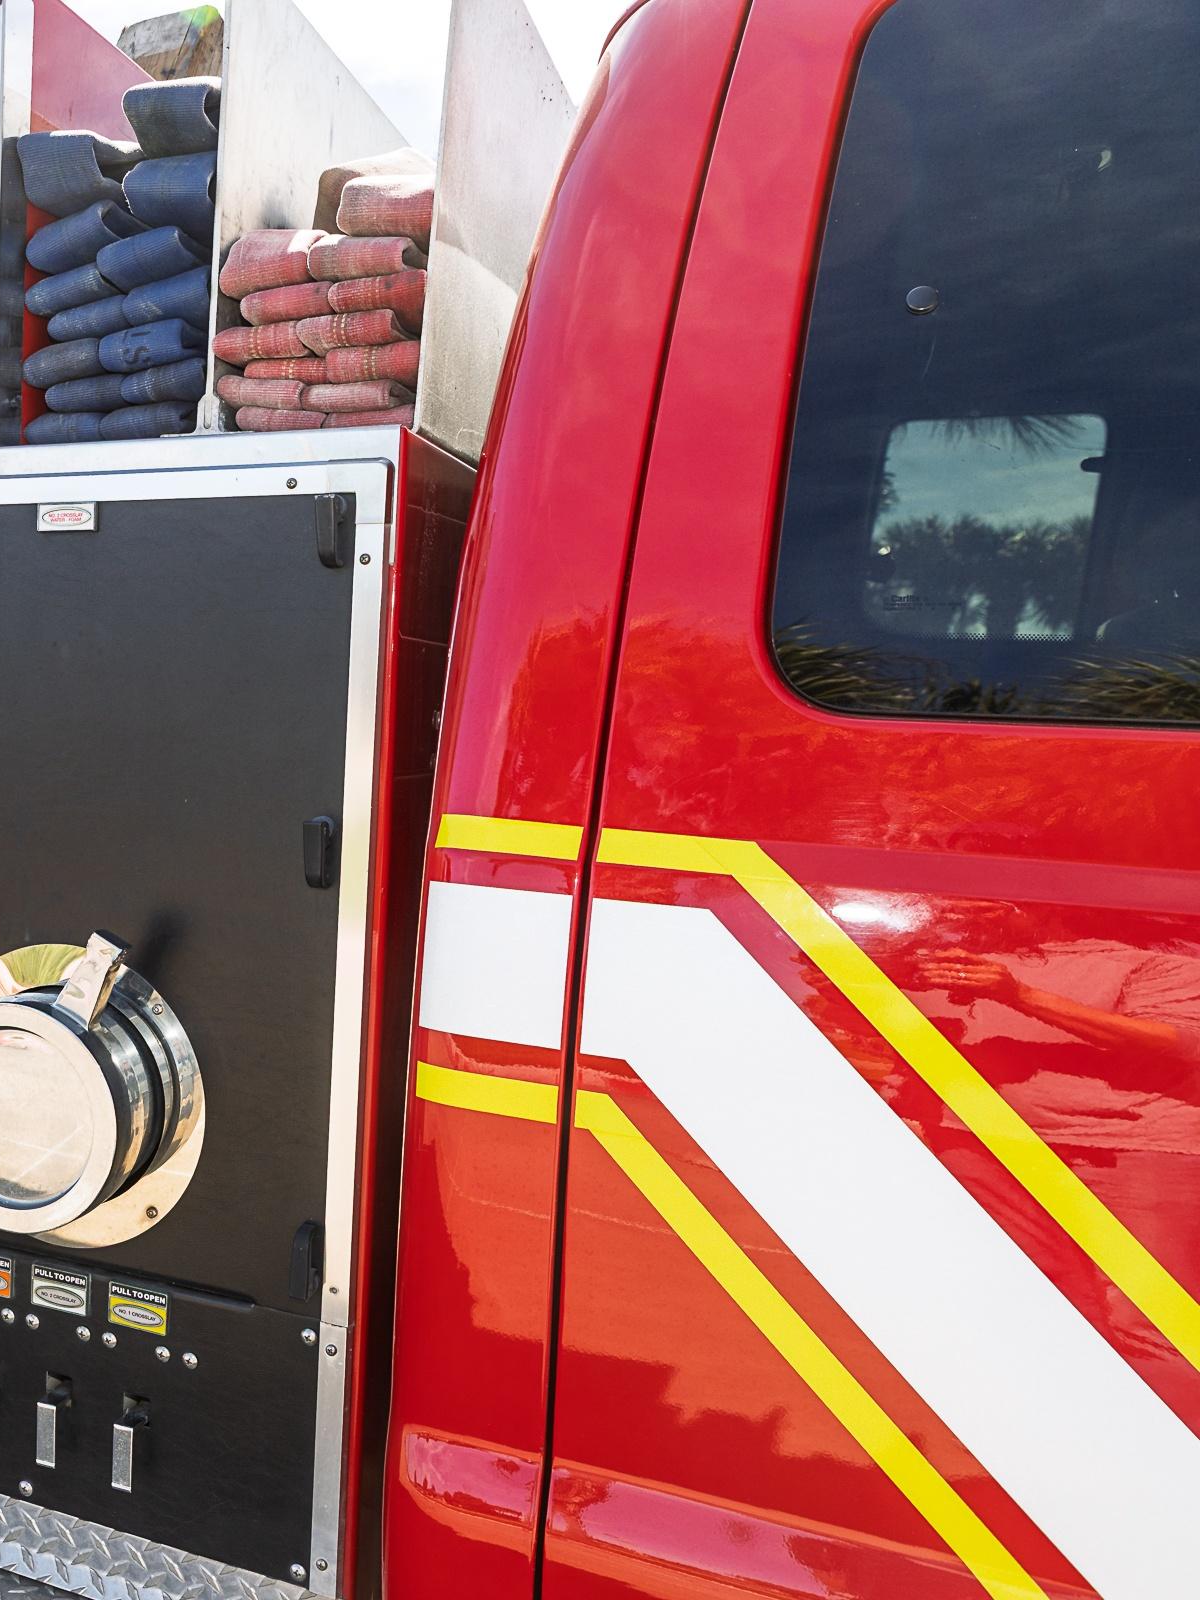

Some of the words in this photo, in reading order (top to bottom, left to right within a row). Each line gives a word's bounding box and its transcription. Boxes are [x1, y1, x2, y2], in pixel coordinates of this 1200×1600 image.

[35, 1268, 53, 1278] PULL
[54, 1272, 64, 1281] TO
[64, 1275, 85, 1286] OPEN
[112, 1285, 132, 1297] PULL
[132, 1290, 143, 1299] TO
[144, 1293, 166, 1304] OPEN
